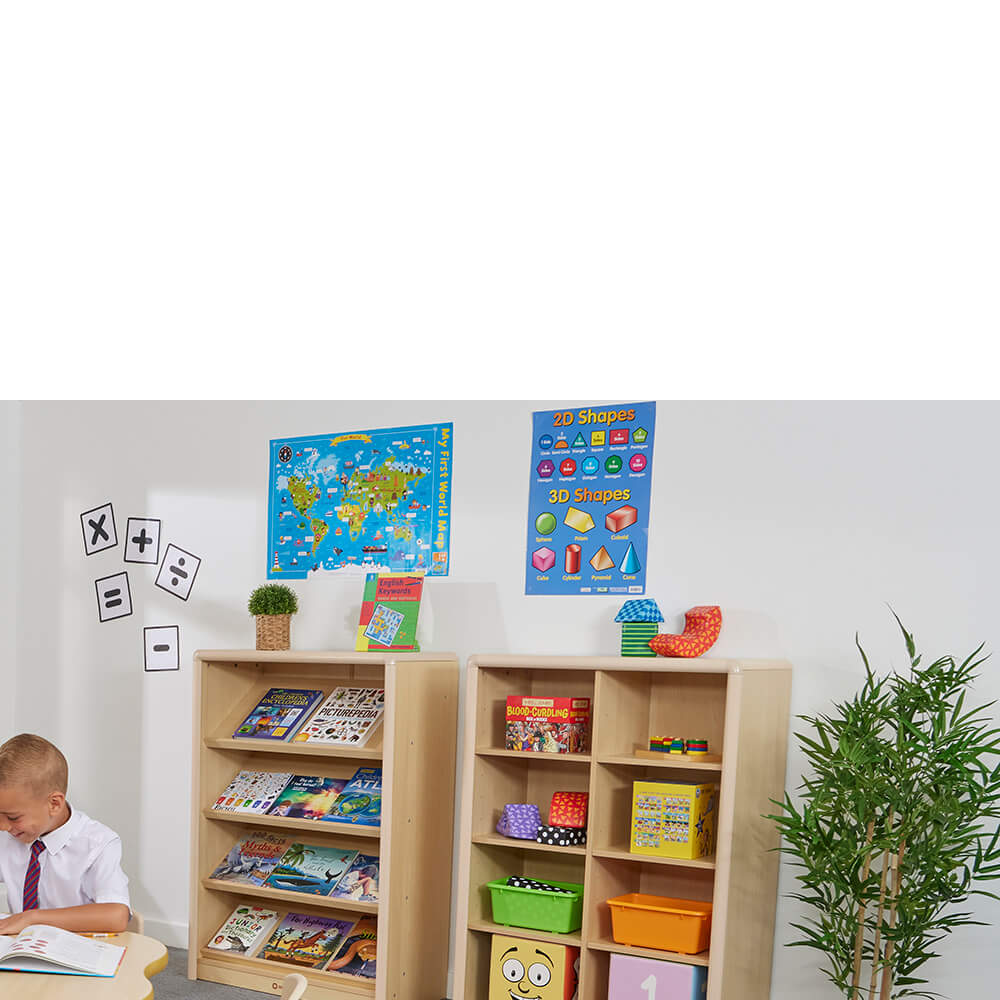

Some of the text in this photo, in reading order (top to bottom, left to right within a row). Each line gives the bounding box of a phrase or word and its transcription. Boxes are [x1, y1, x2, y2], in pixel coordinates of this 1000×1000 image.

[553, 408, 635, 427] 2D Shapes
[433, 427, 451, 549] My First World Map
[548, 487, 631, 505] 3D Shapes
[318, 707, 379, 719] PICTUREPEDIA
[506, 705, 569, 719] BLOOD-CURDLING
[229, 918, 262, 932] JUNIOR
